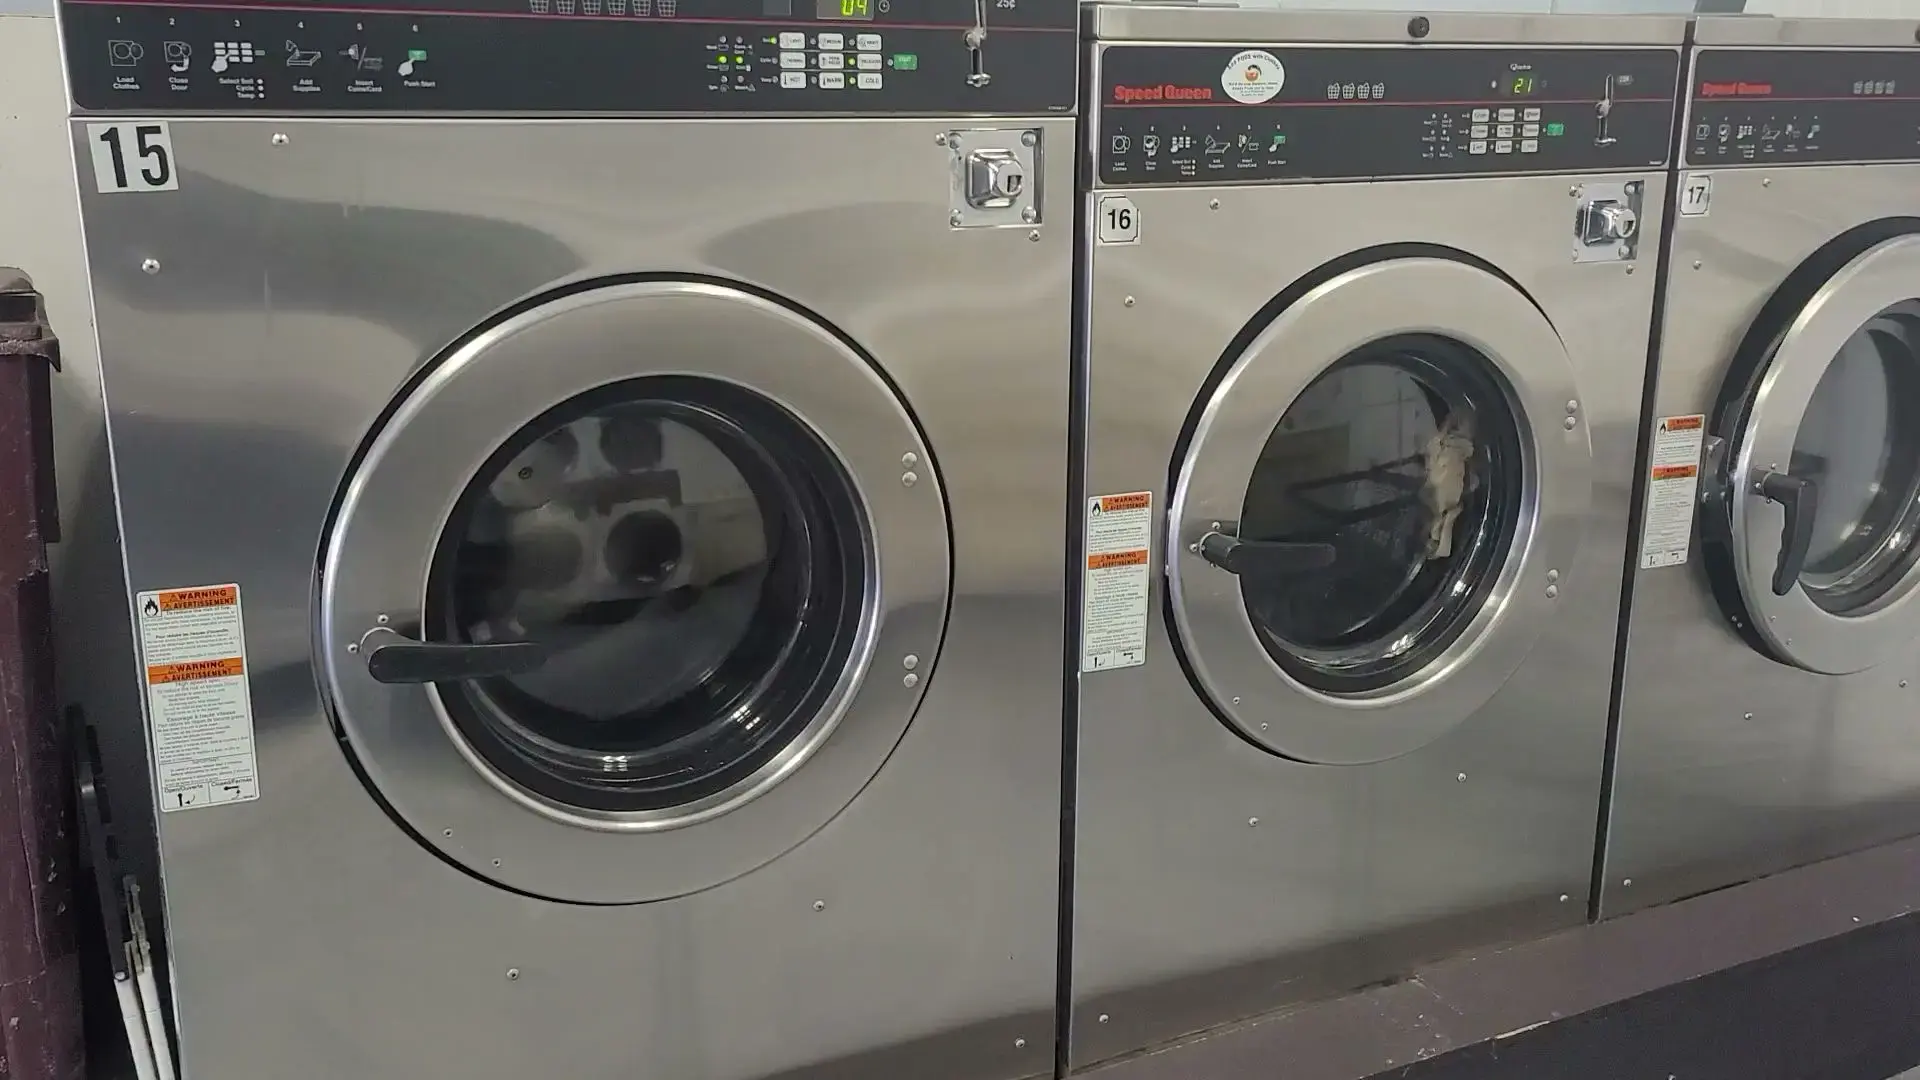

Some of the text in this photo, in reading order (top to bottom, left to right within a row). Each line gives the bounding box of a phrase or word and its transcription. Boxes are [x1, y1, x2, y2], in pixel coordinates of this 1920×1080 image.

[169, 18, 175, 26] 2
[234, 19, 240, 27] 3
[1514, 77, 1532, 94] 21
[1114, 84, 1212, 103] Speed Queen
[100, 125, 170, 188] 15
[1688, 186, 1705, 204] 17
[1108, 209, 1131, 230] 16
[178, 589, 227, 600] WARNING
[173, 598, 234, 609] AVERTISSEMENT
[176, 660, 225, 672] WARNING
[172, 668, 232, 682] AVERTISSEMENT
